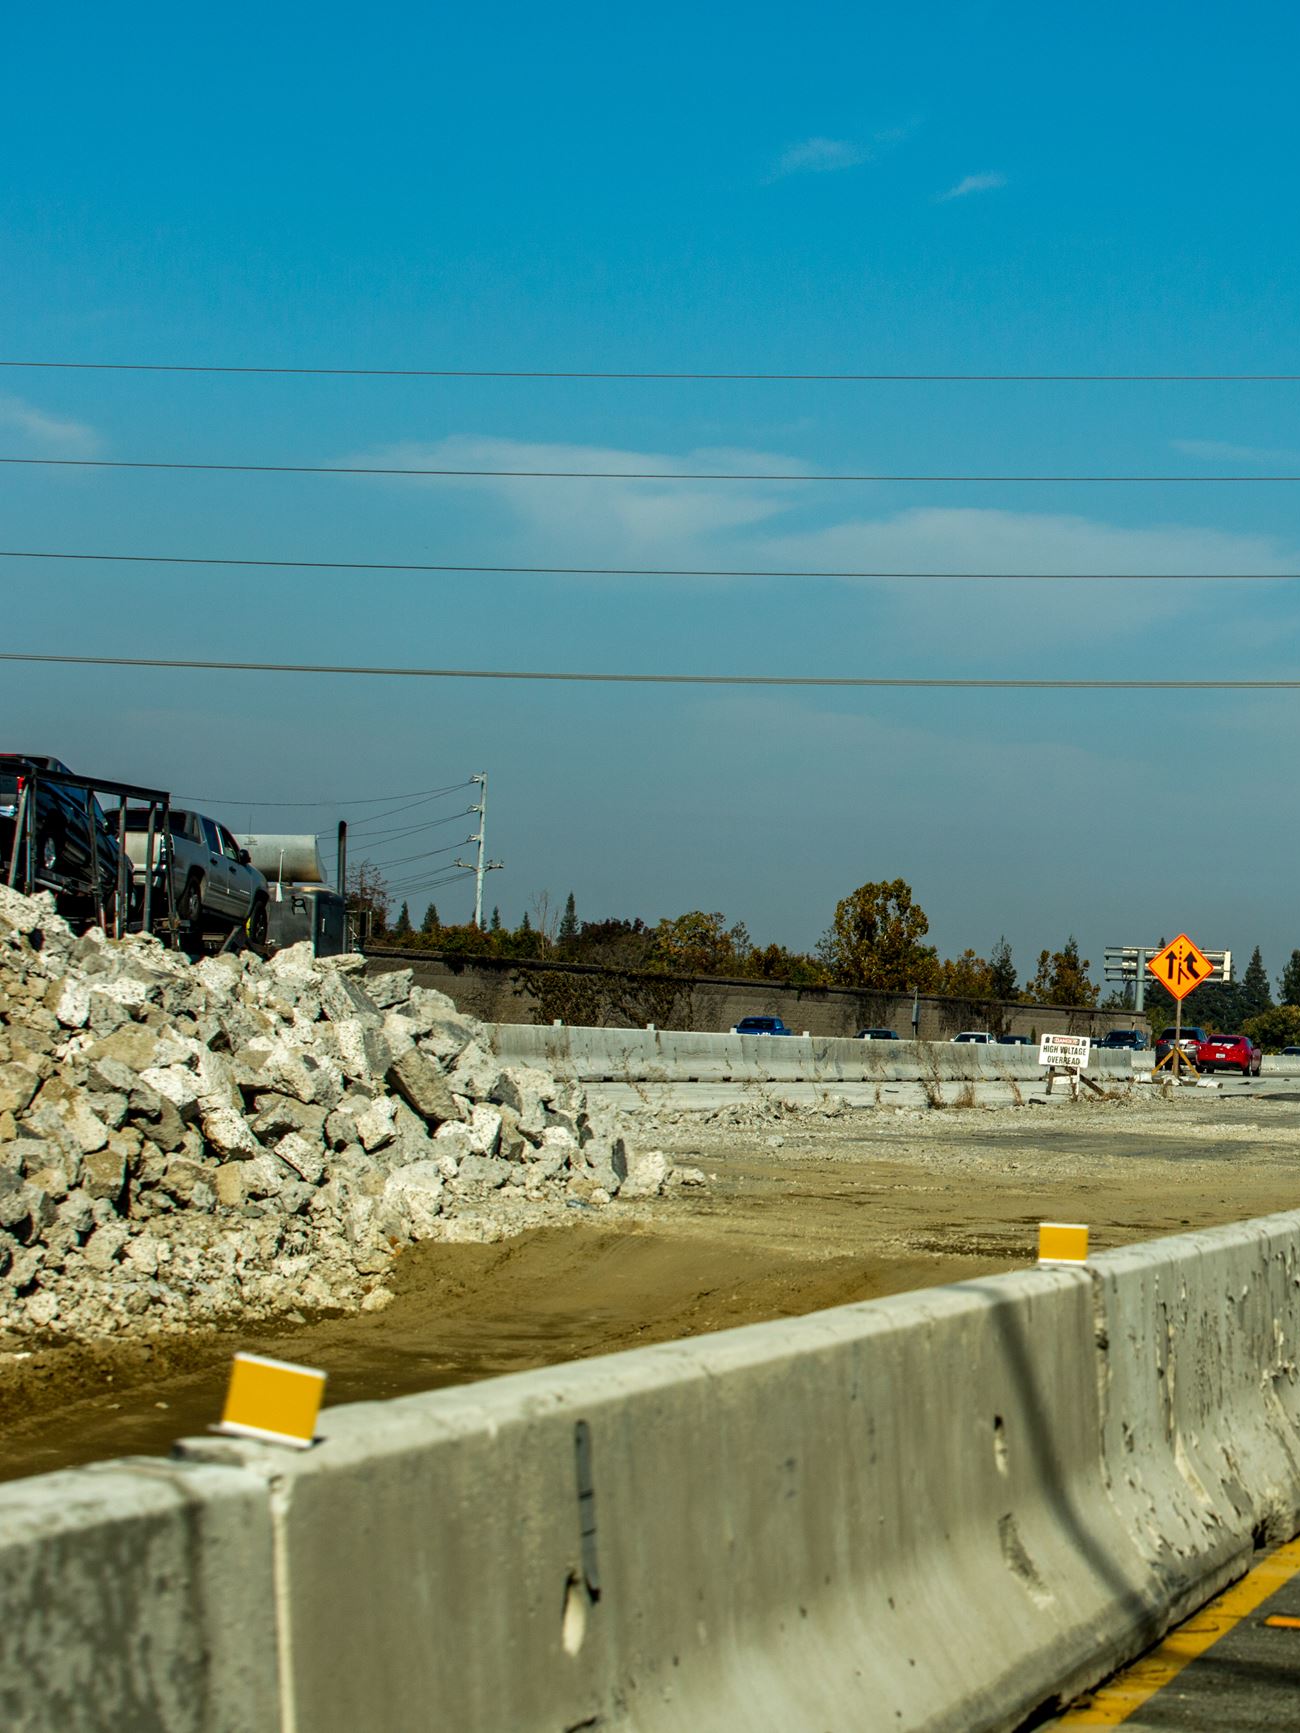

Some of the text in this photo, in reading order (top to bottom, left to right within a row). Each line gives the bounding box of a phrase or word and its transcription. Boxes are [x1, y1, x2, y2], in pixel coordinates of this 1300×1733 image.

[1043, 1045, 1087, 1056] HIGH VOLTAGE
[1047, 1055, 1081, 1065] OVERHEAD
